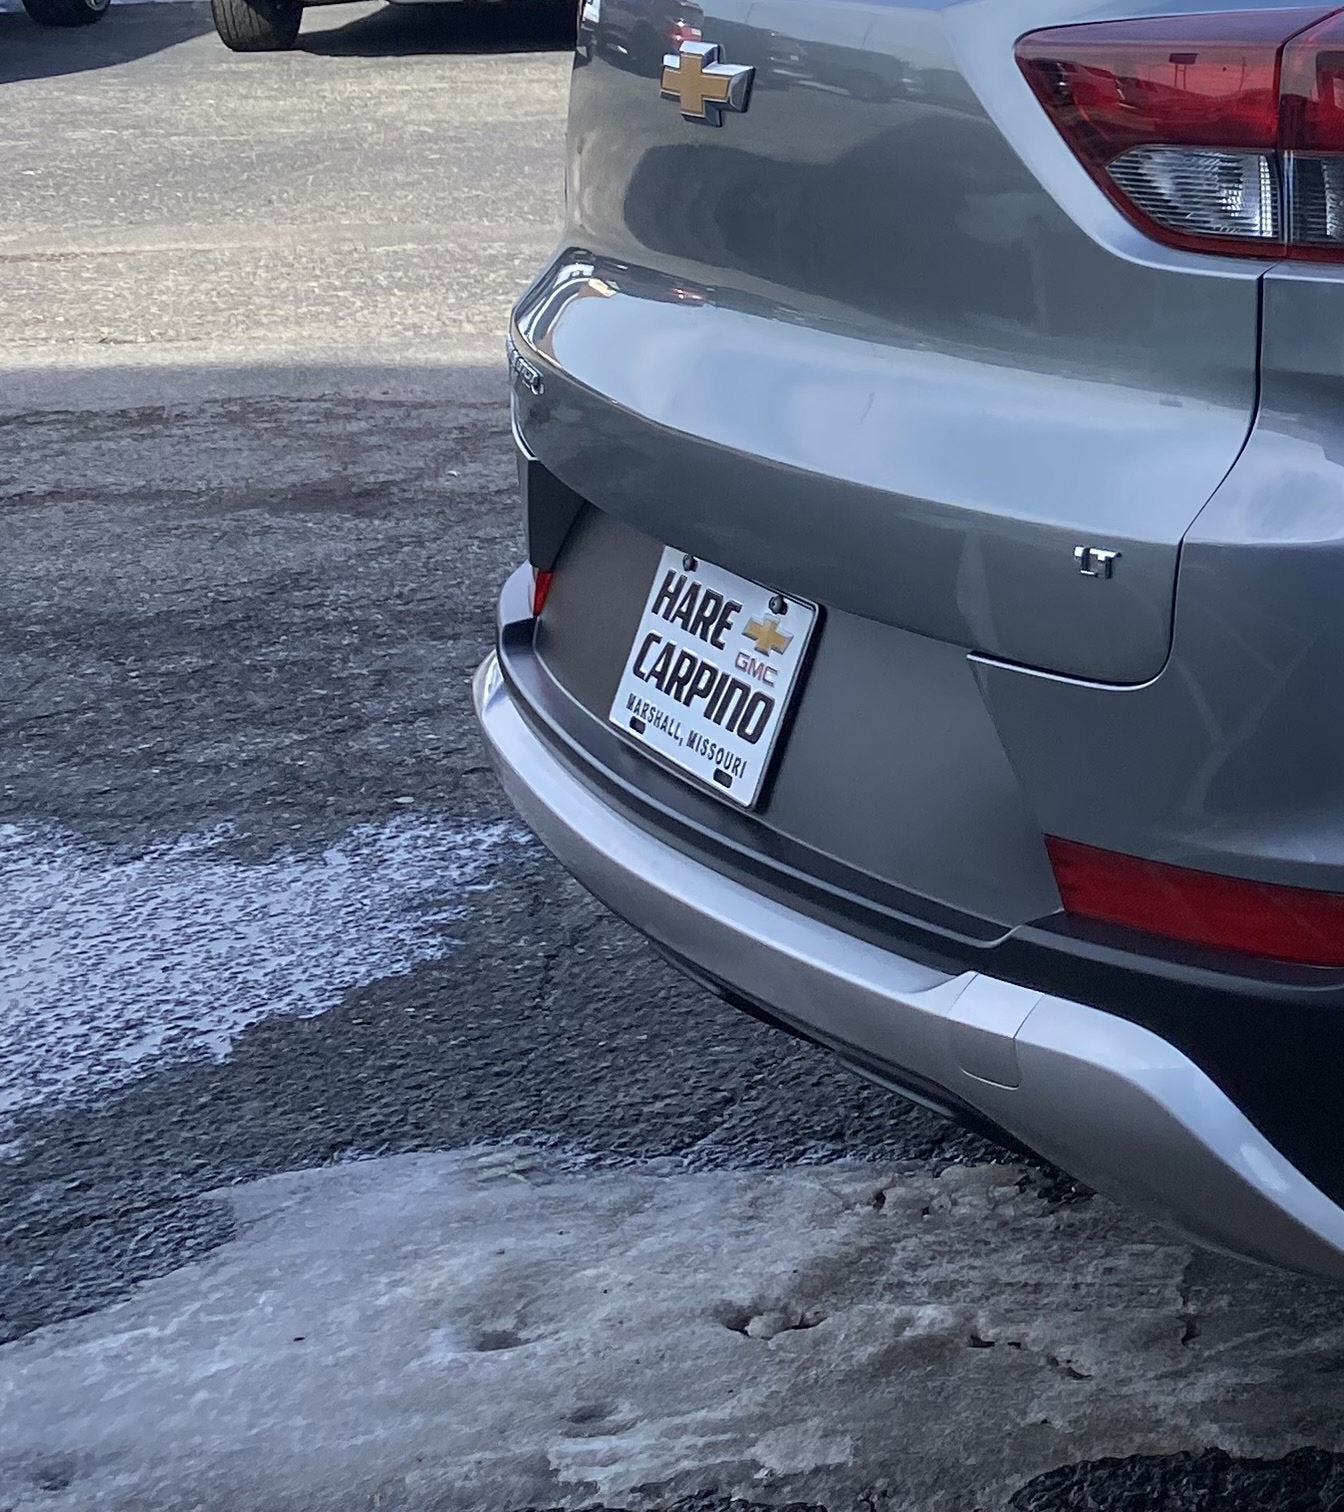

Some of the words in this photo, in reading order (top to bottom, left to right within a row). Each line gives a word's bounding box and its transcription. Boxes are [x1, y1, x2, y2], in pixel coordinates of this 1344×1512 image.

[1074, 546, 1121, 578] LT
[651, 569, 742, 651] HARE
[633, 632, 775, 745] CARPINO
[736, 651, 778, 686] GMC
[626, 693, 684, 747] MARSHALL,
[686, 730, 747, 779] MISSOURI
